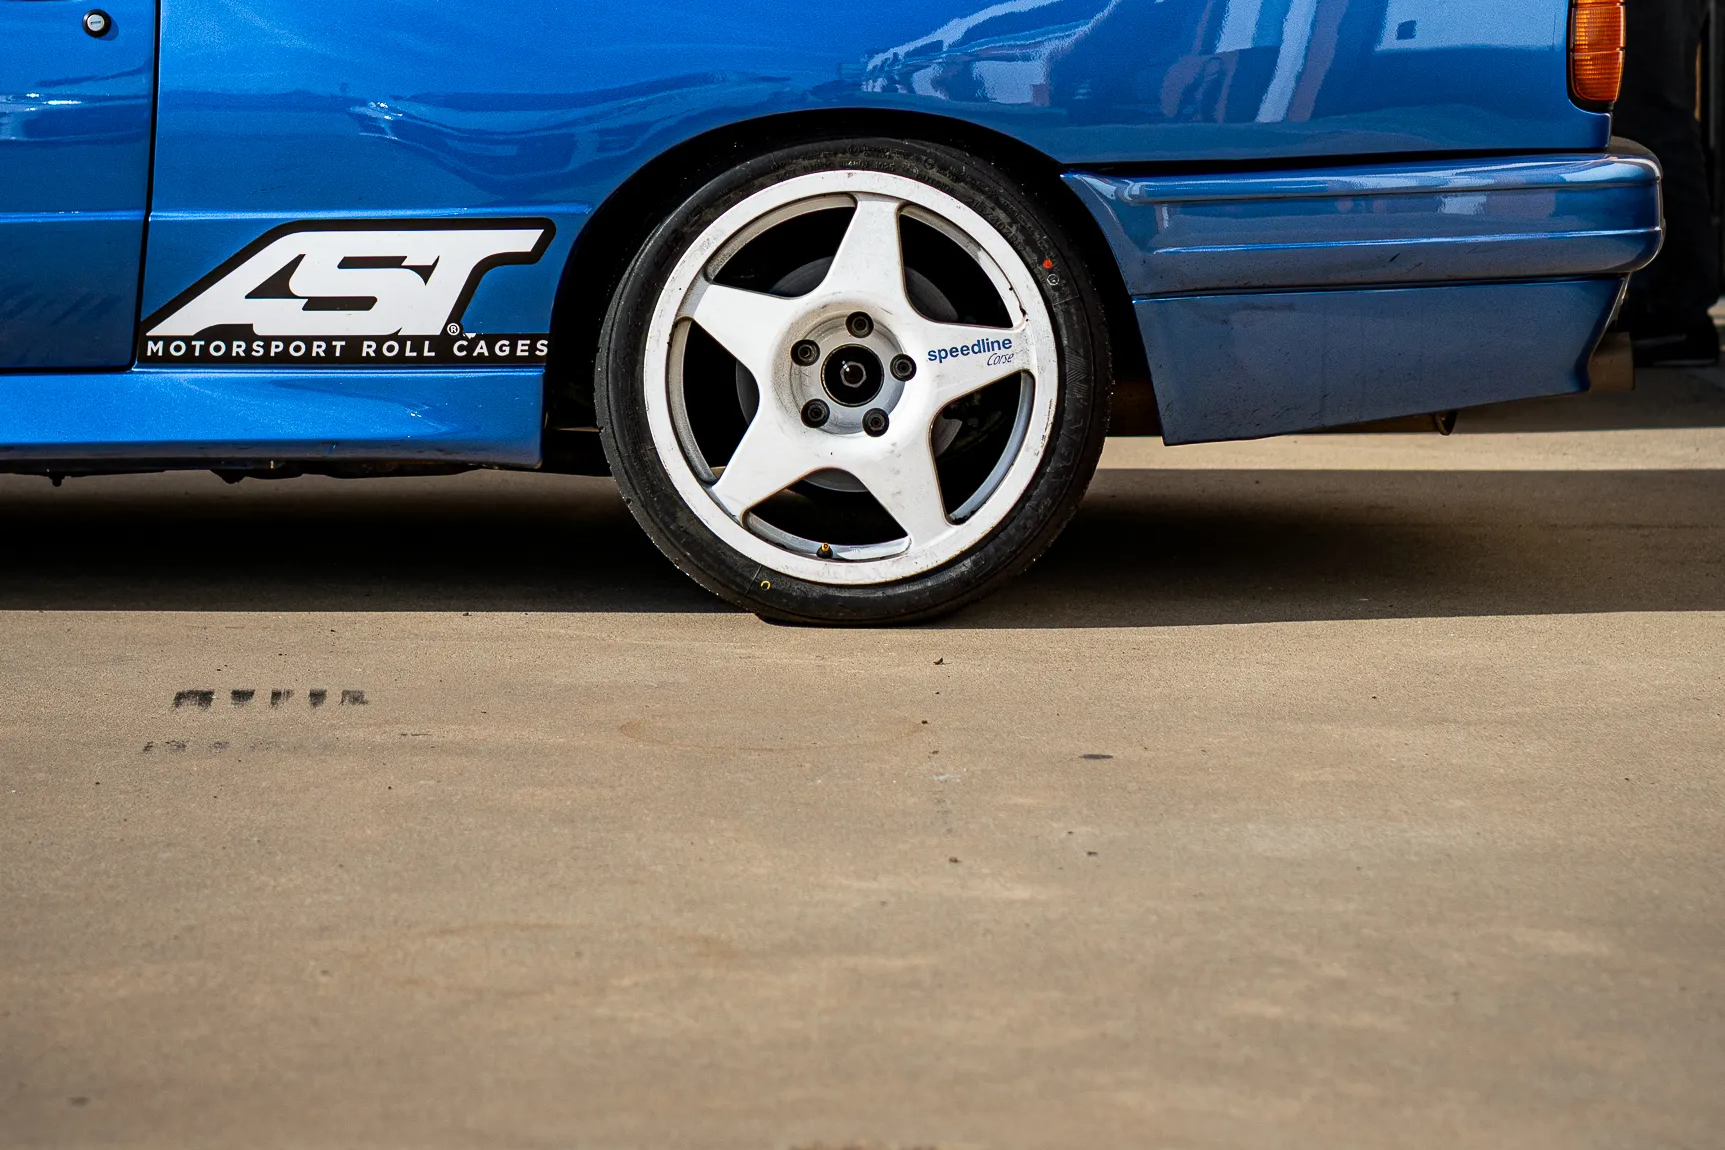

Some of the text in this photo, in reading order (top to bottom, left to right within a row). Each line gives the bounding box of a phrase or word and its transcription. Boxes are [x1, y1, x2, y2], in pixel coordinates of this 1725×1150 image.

[145, 229, 545, 337] AST
[146, 339, 549, 357] MOTORSPORT ROLL CAGES
[927, 337, 1013, 364] speedline
[986, 352, 1015, 366] Corse
